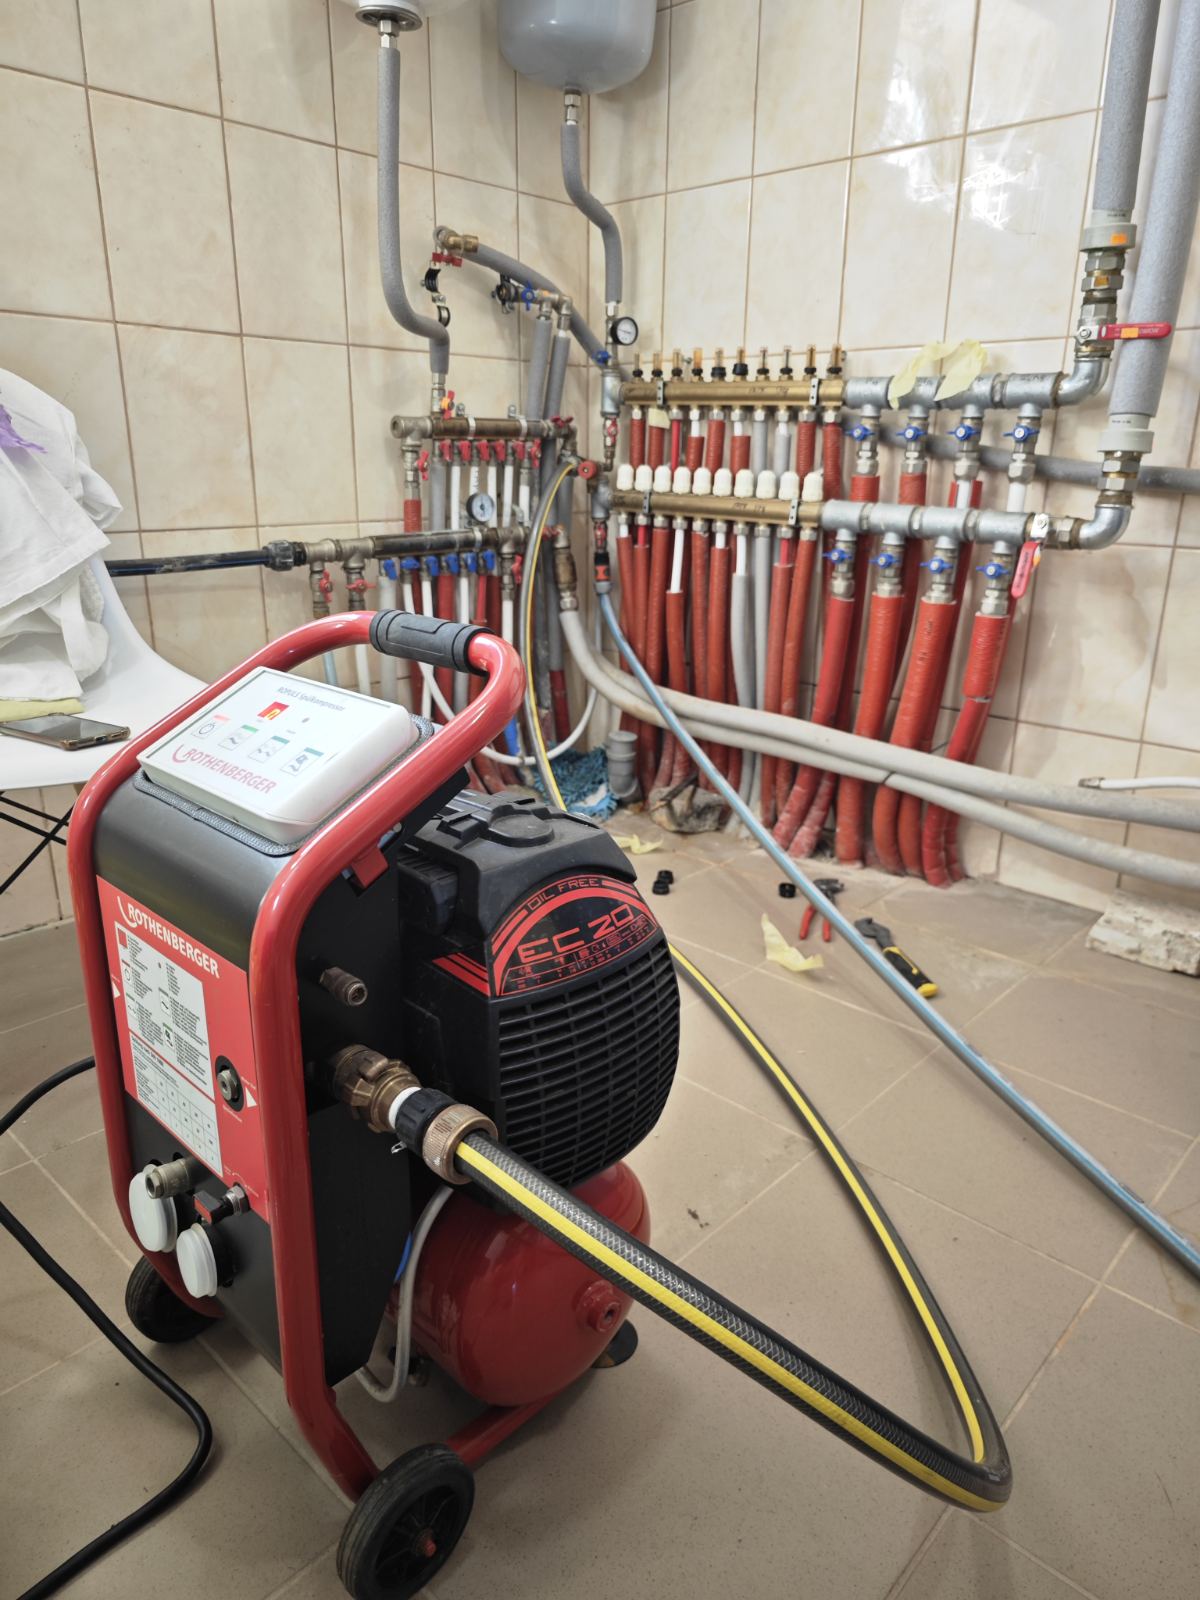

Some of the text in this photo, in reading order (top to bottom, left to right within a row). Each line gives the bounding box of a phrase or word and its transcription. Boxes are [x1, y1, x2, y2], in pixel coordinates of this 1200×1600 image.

[183, 748, 277, 794] ROTHENBERGER
[527, 878, 600, 911] OIL FREE
[127, 902, 220, 979] ROTHENBERGER
